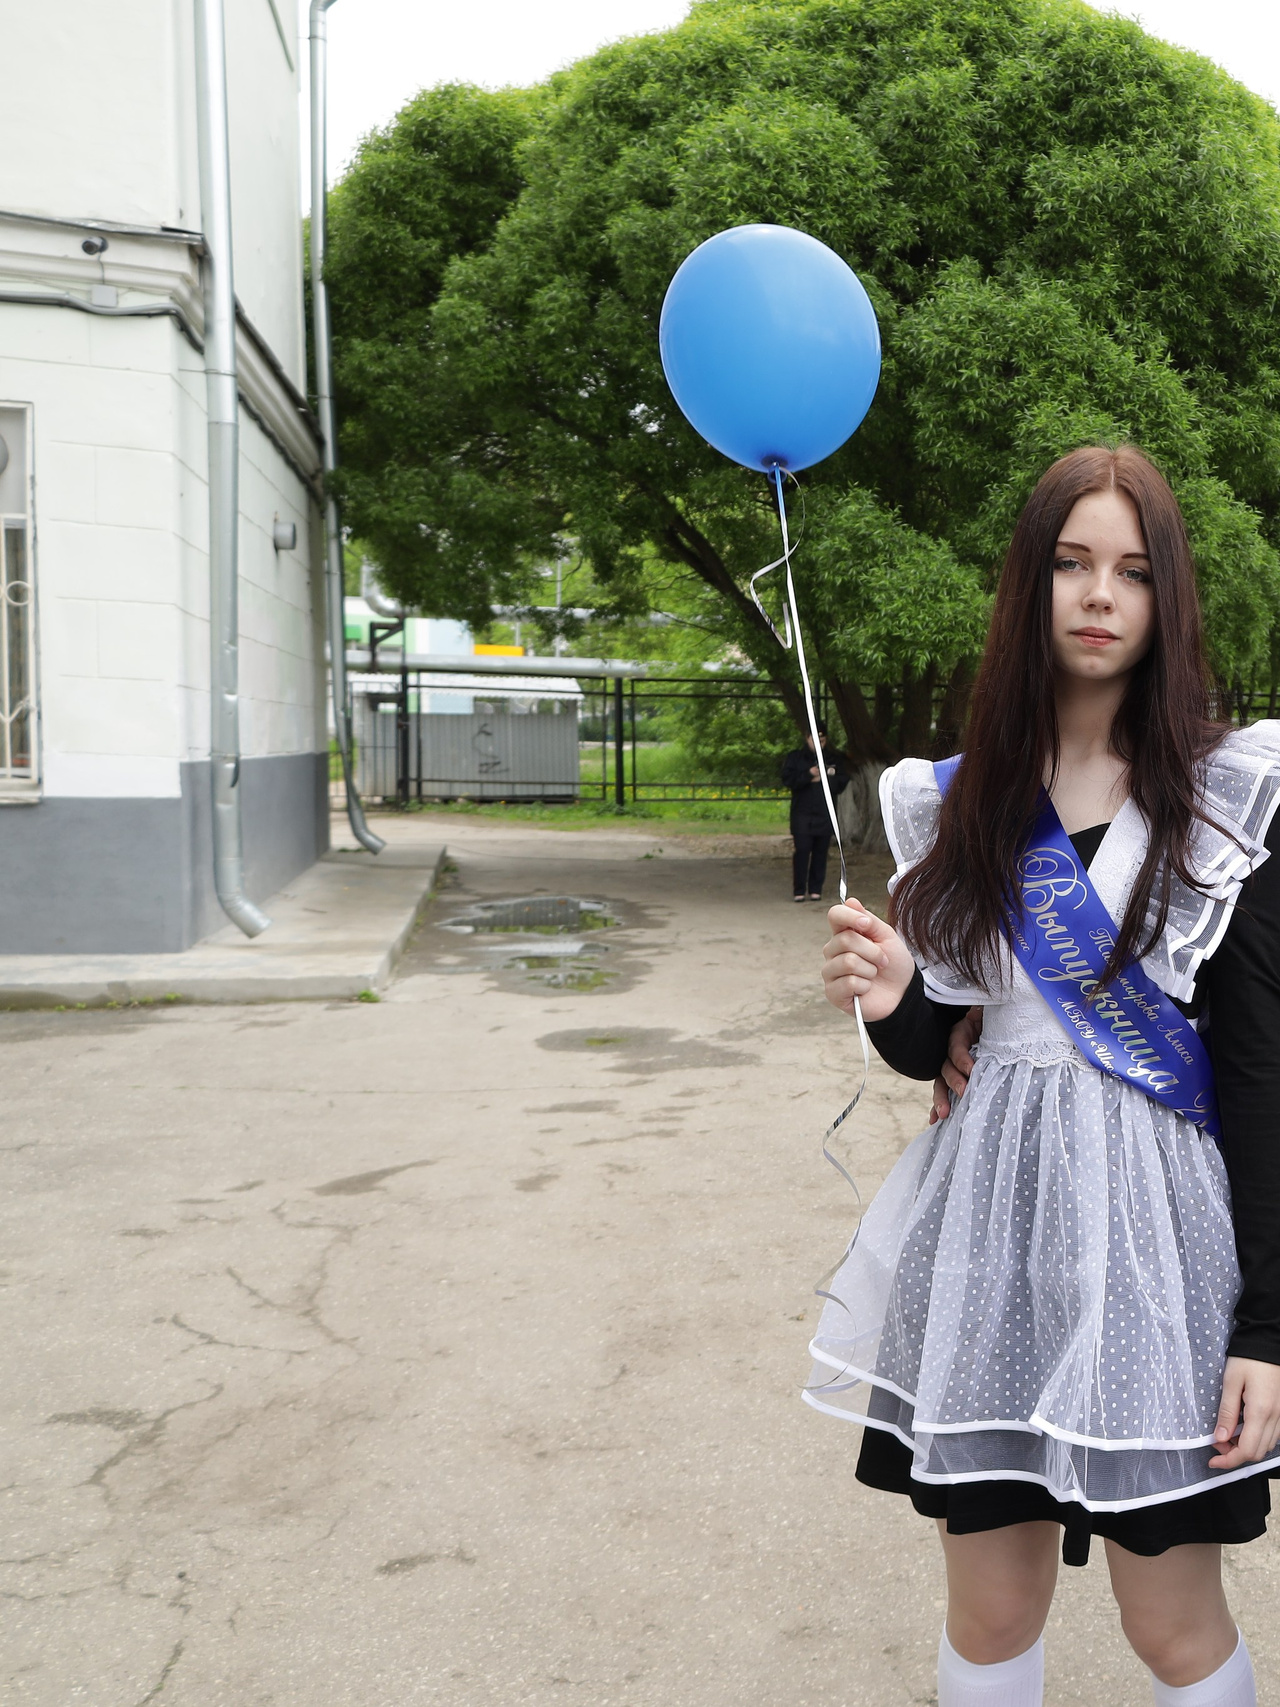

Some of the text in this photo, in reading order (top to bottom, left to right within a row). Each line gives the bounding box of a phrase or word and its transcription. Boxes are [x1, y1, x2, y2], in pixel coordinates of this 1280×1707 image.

[1017, 847, 1179, 1094] Выпускница
[1057, 998, 1097, 1038] МБОУ
[1089, 927, 1194, 1066] Тимирова Алиса
